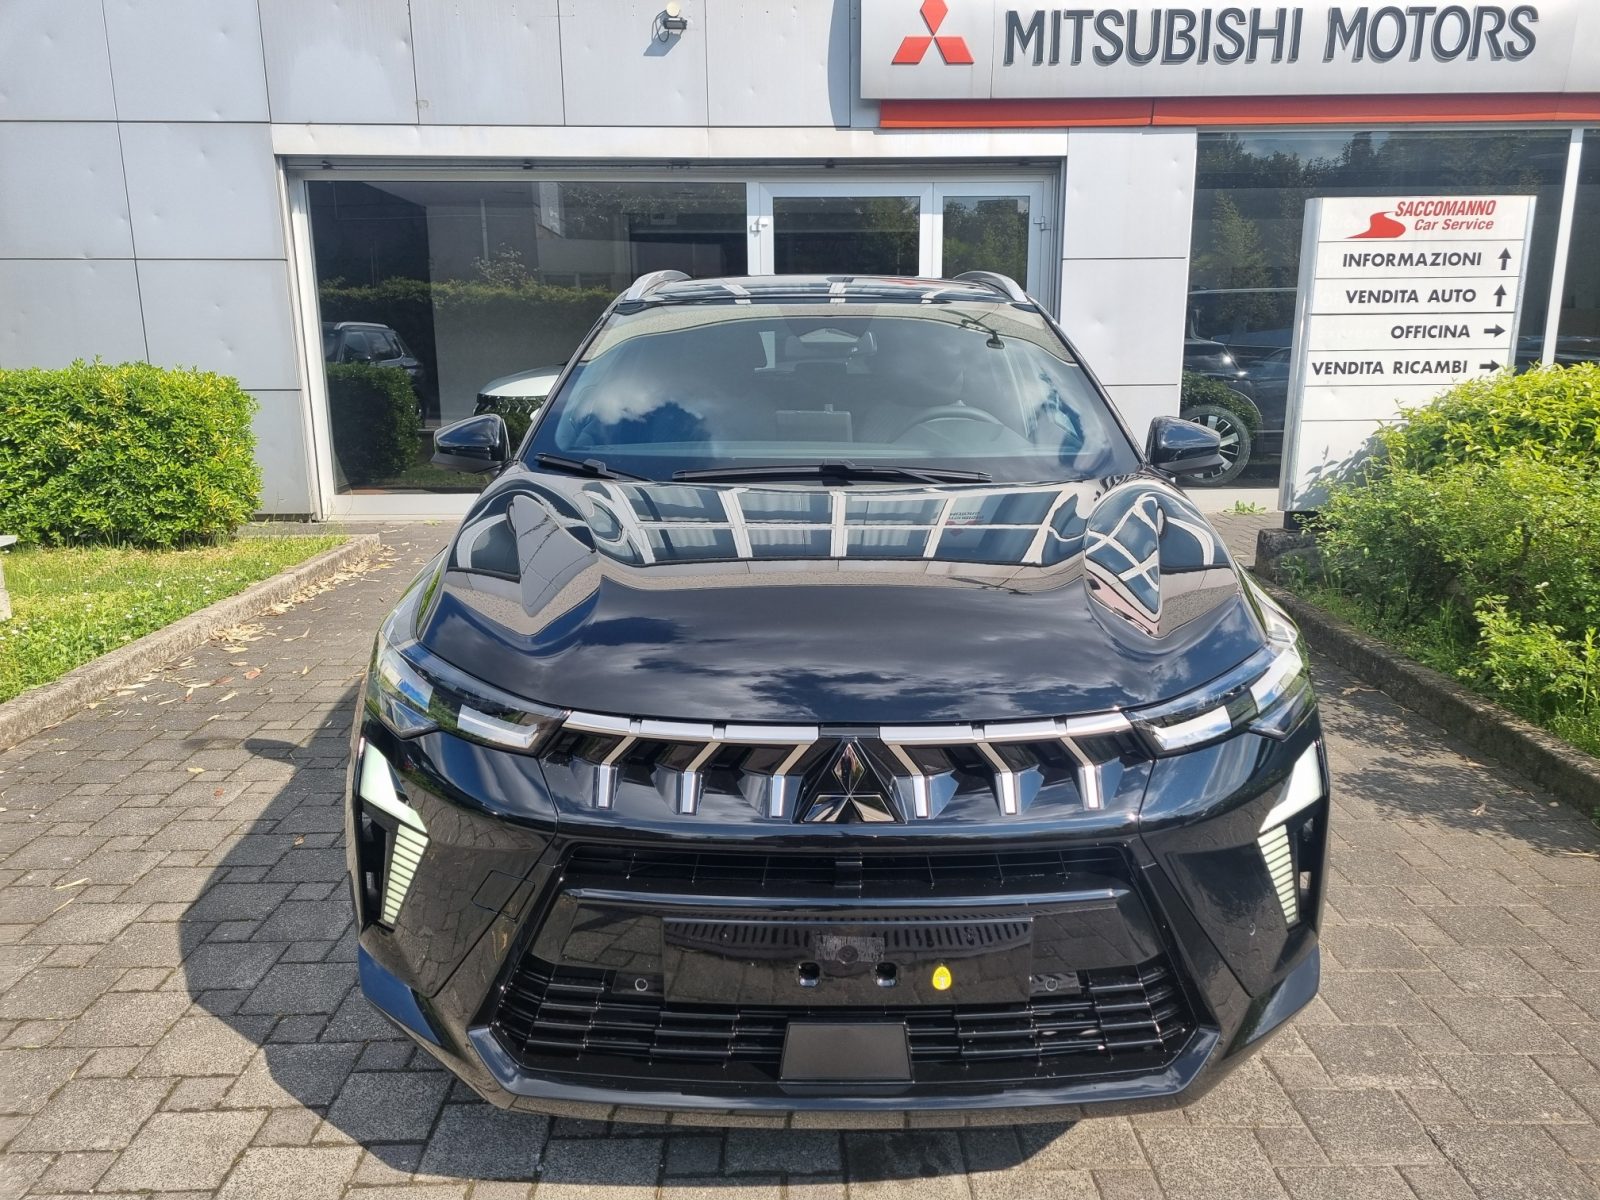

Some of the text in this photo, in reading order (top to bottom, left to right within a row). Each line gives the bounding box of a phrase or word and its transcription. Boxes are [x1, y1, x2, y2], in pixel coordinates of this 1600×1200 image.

[1003, 5, 1539, 66] MITSUBISHI MOTORS
[1394, 200, 1497, 217] SACCOMANNO
[1414, 218, 1494, 231] Car Service
[1342, 252, 1482, 267] INFORMAZIONI
[1345, 289, 1477, 304] VENDITA AUTO
[1390, 325, 1471, 339] OFFICINA
[1312, 360, 1468, 375] VENDITA RICAMBI
